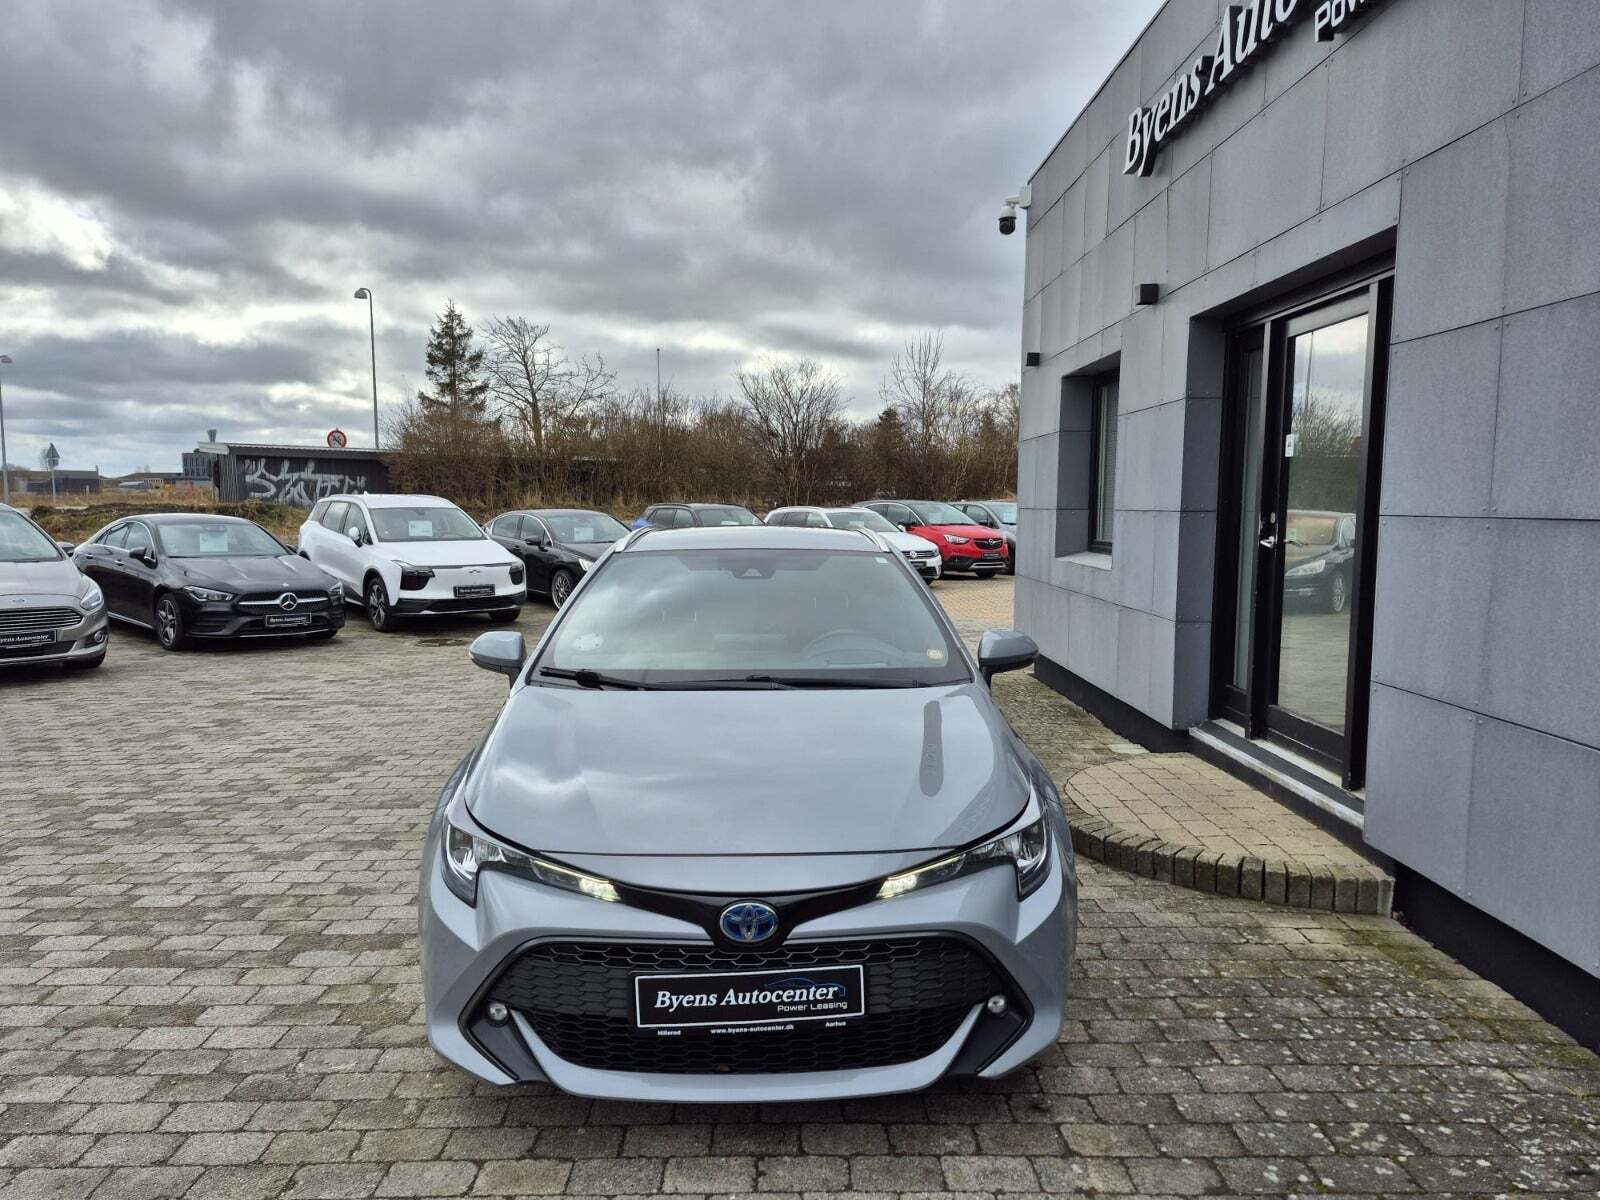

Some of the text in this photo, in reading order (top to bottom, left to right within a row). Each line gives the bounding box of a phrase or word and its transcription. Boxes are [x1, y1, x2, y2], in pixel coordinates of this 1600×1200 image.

[1122, 57, 1203, 177] Byens
[654, 986, 838, 1012] Byens Autocenter
[777, 1001, 848, 1012] Power Leasing
